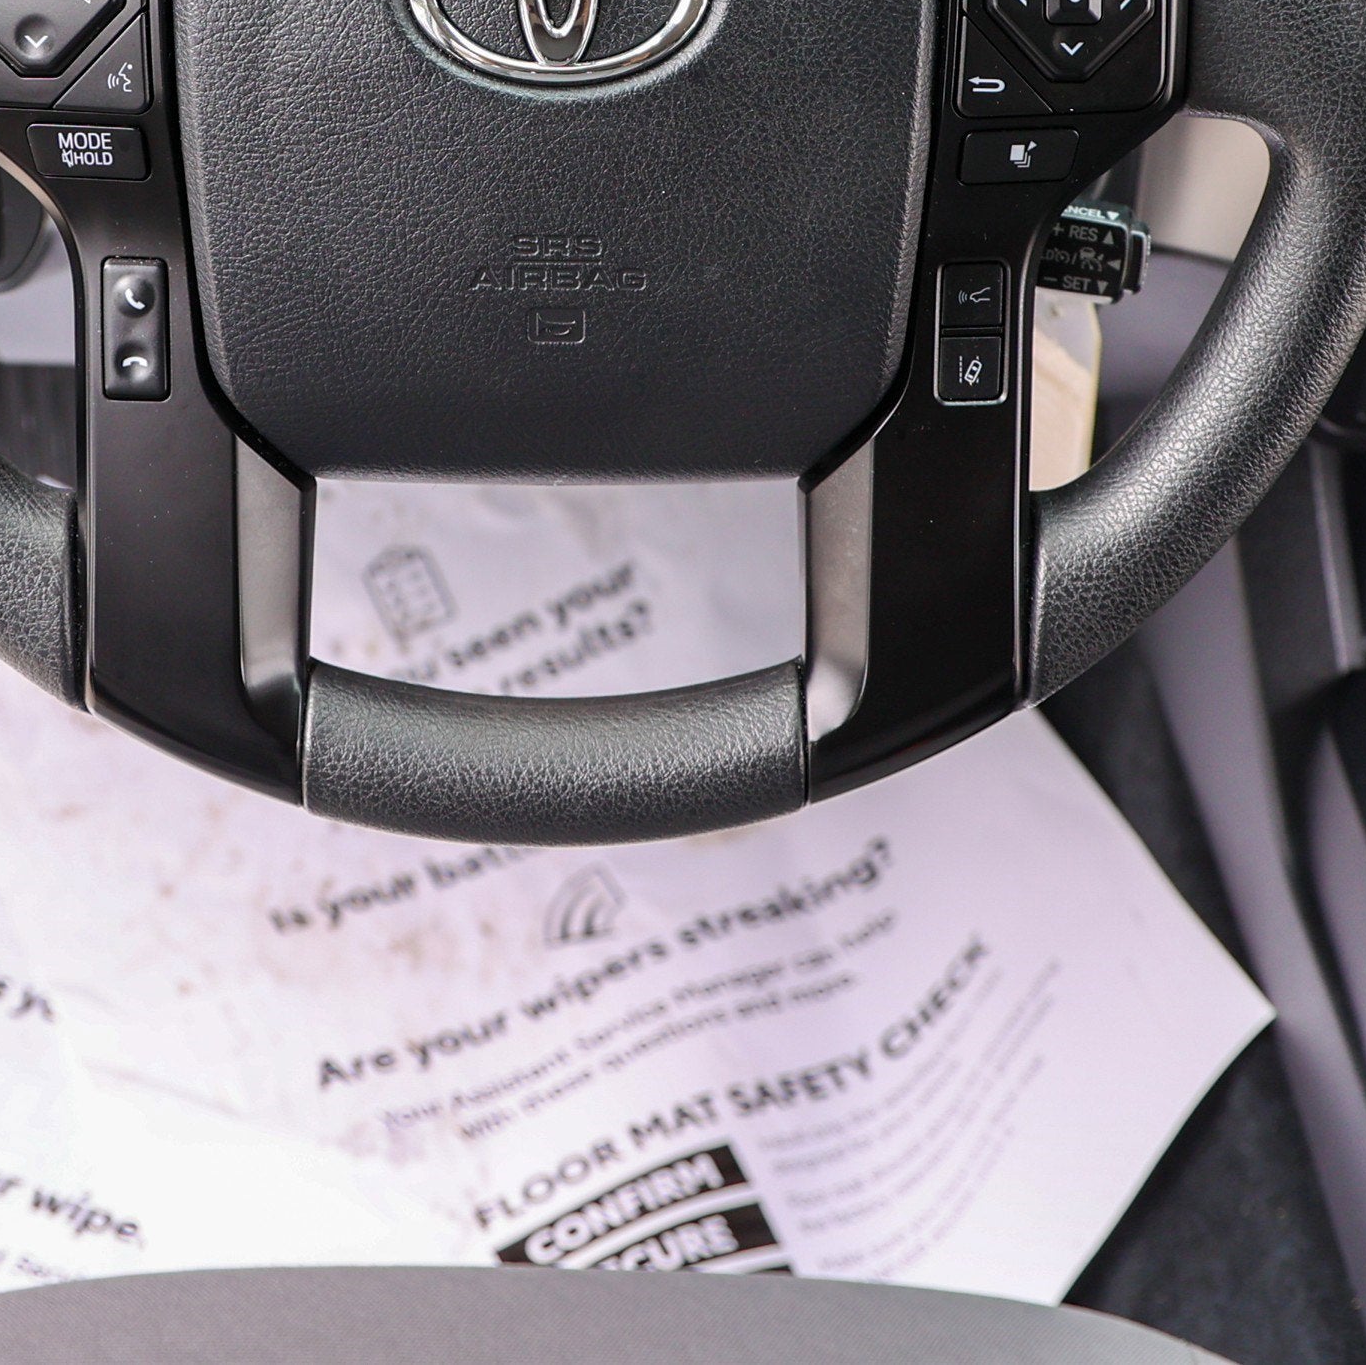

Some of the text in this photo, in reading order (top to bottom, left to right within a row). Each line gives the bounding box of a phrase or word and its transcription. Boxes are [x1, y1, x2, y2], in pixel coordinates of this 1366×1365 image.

[58, 132, 113, 150] MODE
[74, 152, 113, 165] HOLD
[1062, 204, 1106, 220] NCEL
[512, 234, 605, 258] SRS
[1069, 225, 1098, 242] RES
[468, 266, 647, 292] AIRBAG
[1063, 275, 1091, 292] SET
[445, 610, 538, 667] seen
[547, 560, 635, 625] your
[270, 906, 311, 934] Is
[317, 872, 416, 931] your
[319, 836, 893, 1091] Are your wipers streaking?
[474, 930, 990, 1232] FLOOR MAT SAFETY CHECK
[525, 1152, 725, 1266] CONFIRM
